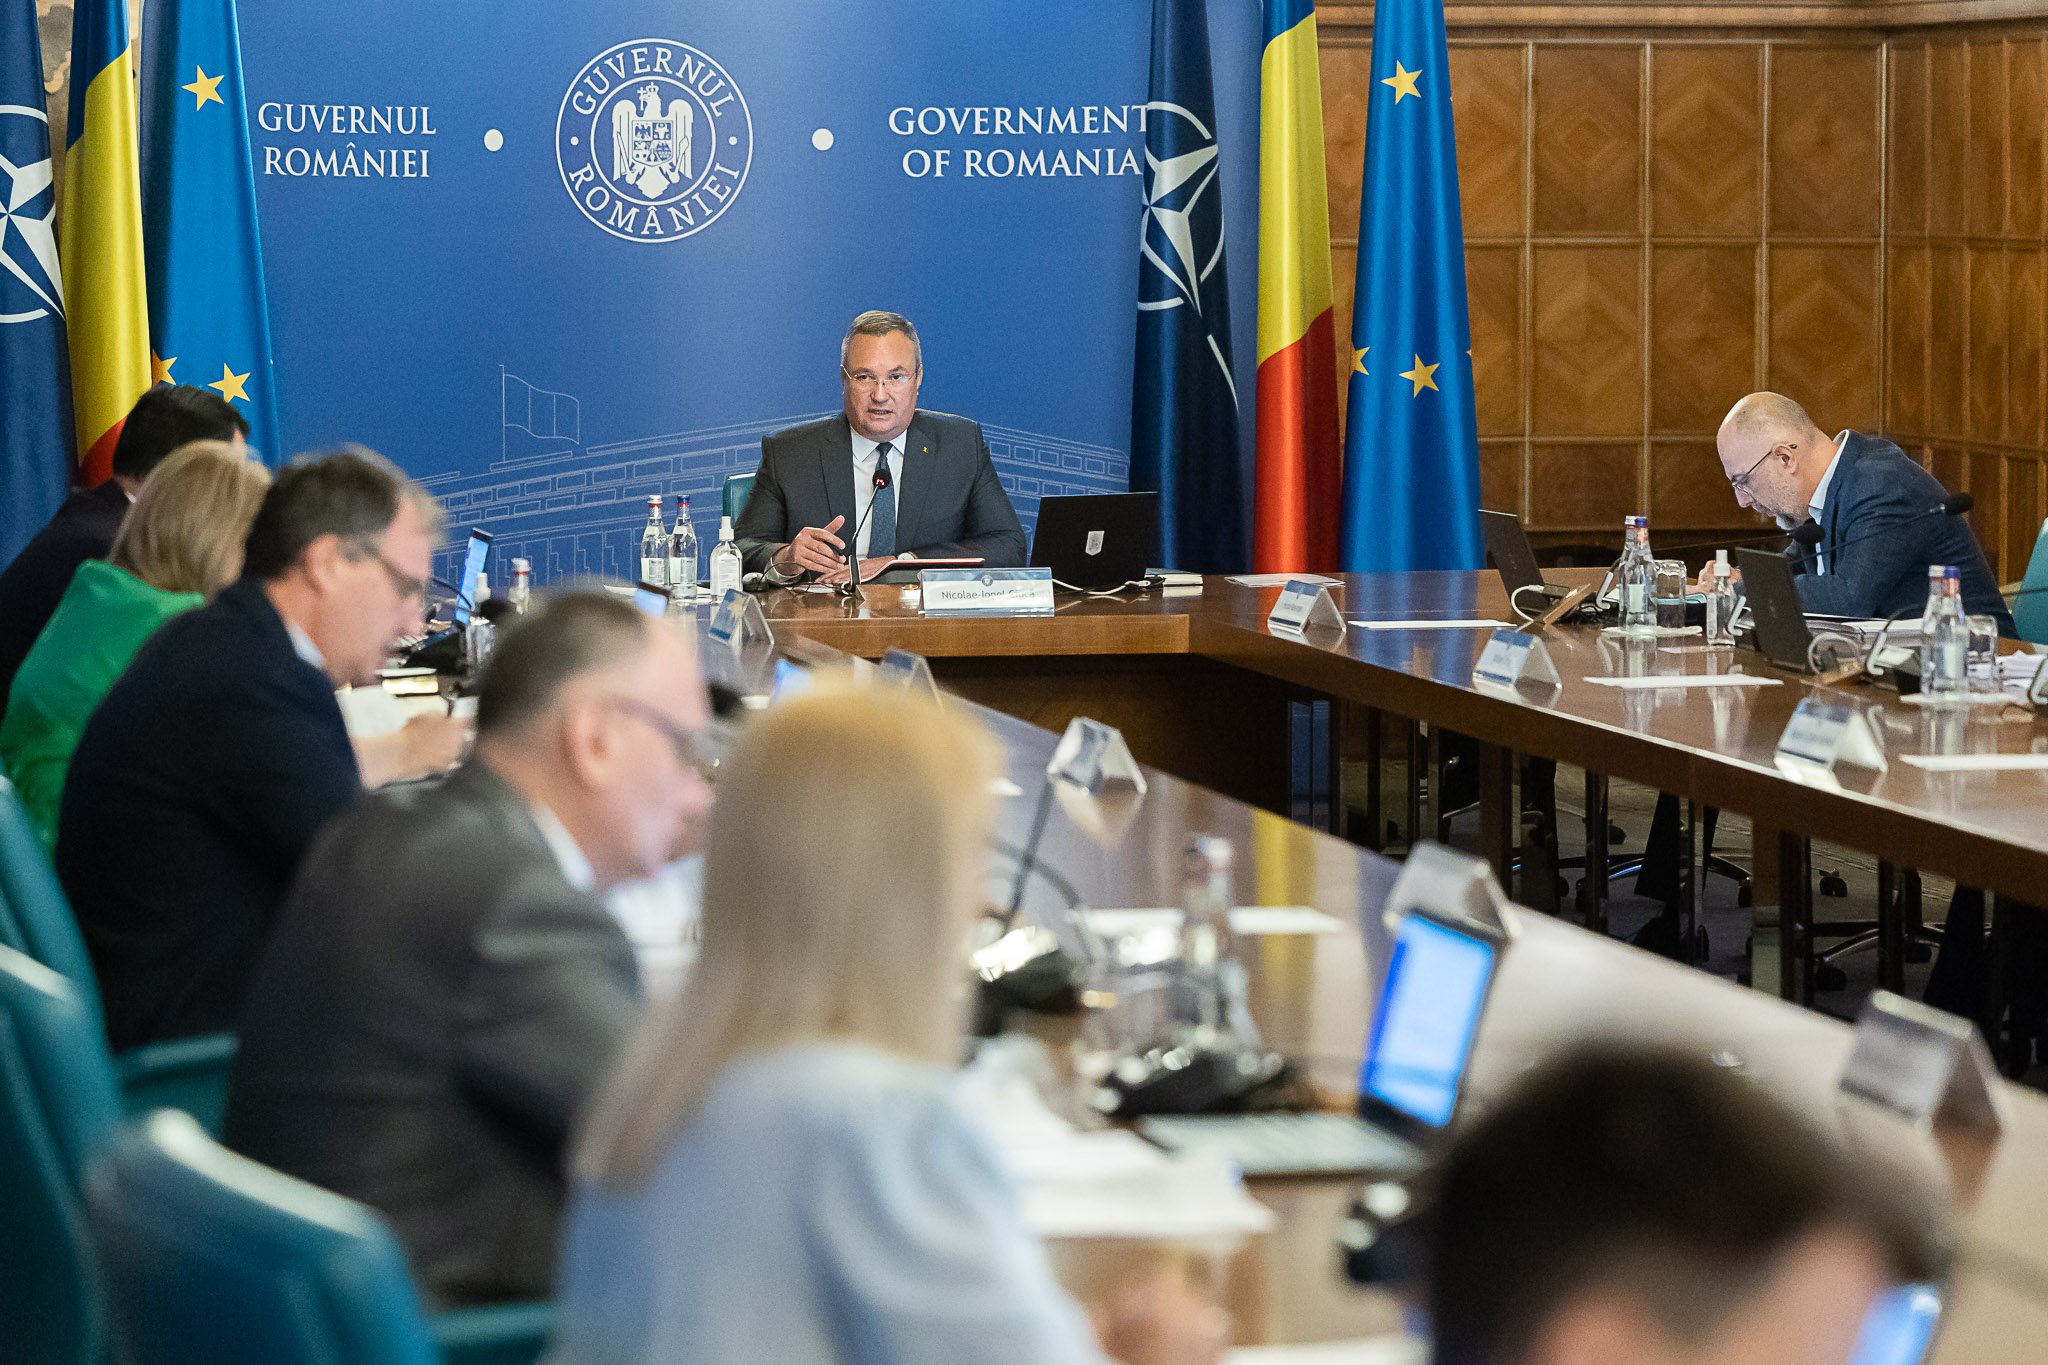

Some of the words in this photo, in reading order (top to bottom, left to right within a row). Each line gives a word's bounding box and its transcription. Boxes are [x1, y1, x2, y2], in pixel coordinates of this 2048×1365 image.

[572, 47, 735, 118] GUVERNUL
[258, 102, 437, 135] GUVERNUL
[888, 105, 1148, 135] GOVERNMENT
[263, 141, 431, 178] ROMÂNIEI
[902, 149, 950, 178] OF
[964, 148, 1143, 178] ROMANIA
[568, 162, 740, 235] ROMÂNIEI
